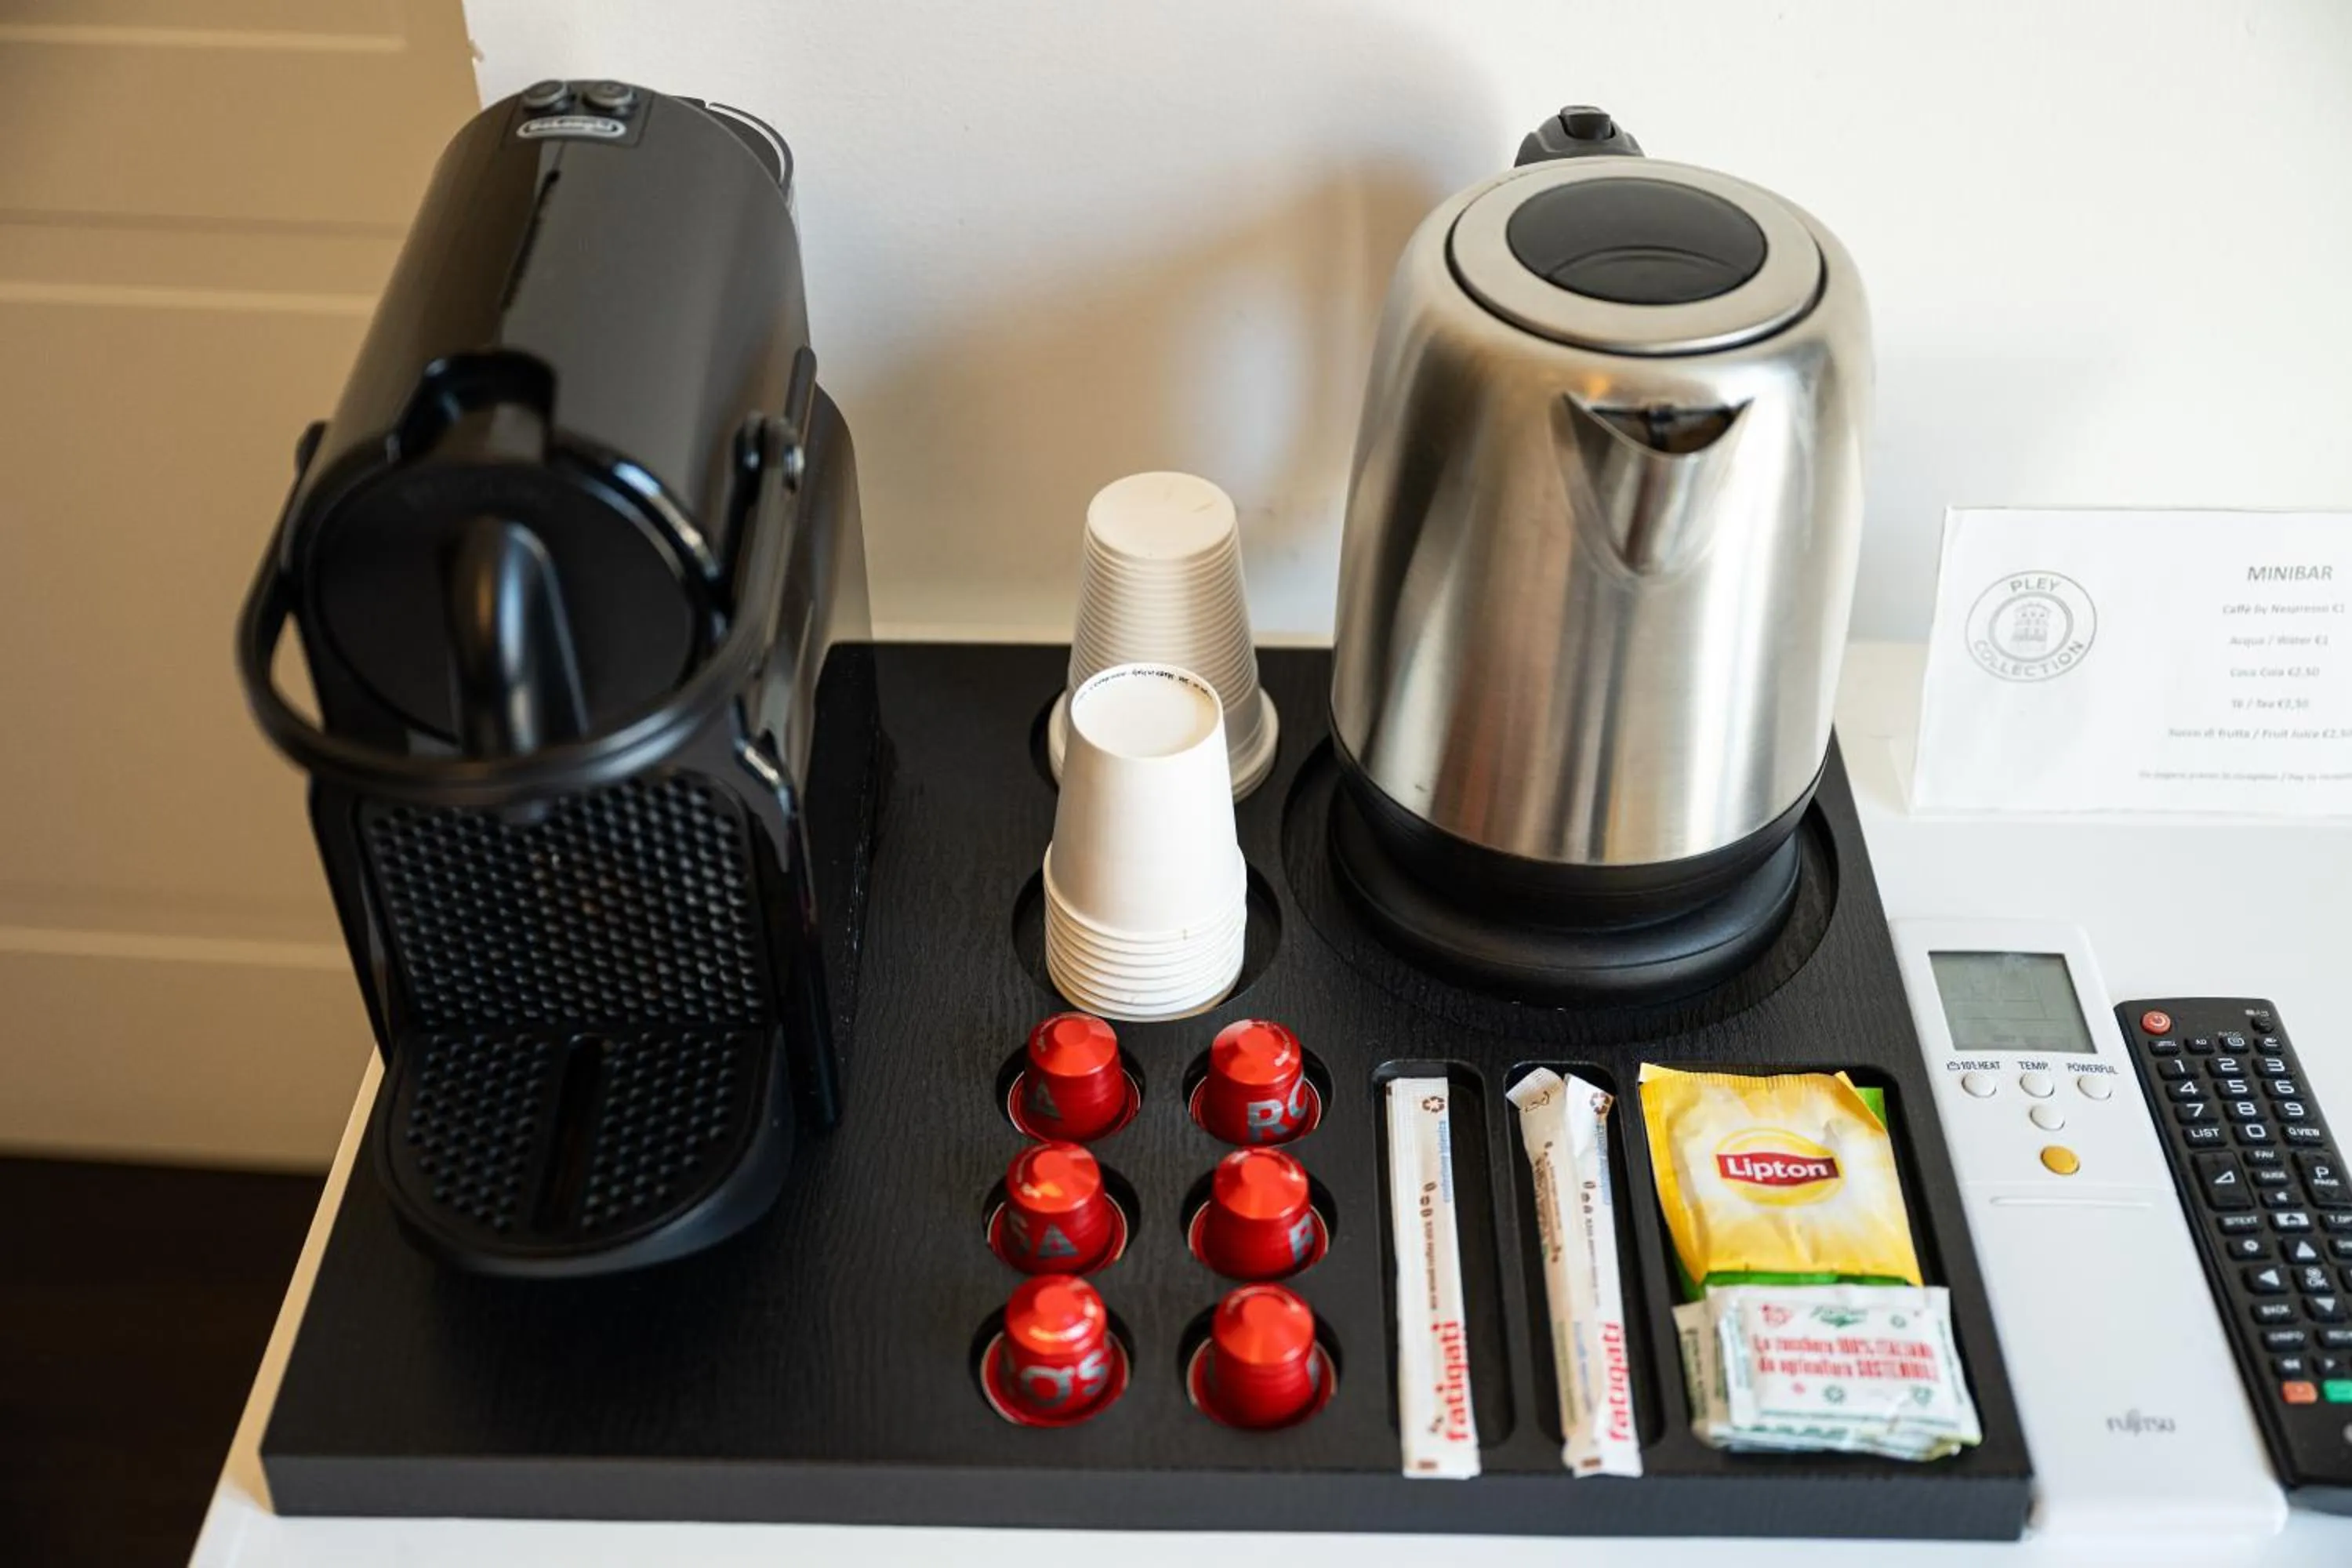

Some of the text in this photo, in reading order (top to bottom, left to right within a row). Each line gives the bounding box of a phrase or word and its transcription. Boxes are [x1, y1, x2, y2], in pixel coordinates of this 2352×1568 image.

[2247, 565, 2333, 581] MINIBAR
[2009, 577, 2061, 593] PLEY
[1973, 640, 2084, 677] COLLECTION
[2066, 1062, 2119, 1075] POWERFUL
[2174, 1058, 2285, 1073] 1 2 3
[2180, 1080, 2295, 1094] 4 5 6
[2187, 1102, 2304, 1116] 7 8 9
[2191, 1128, 2219, 1138] LIST
[2245, 1124, 2266, 1138] 0
[1726, 1157, 1828, 1181] Lipton
[2315, 1167, 2328, 1178] P
